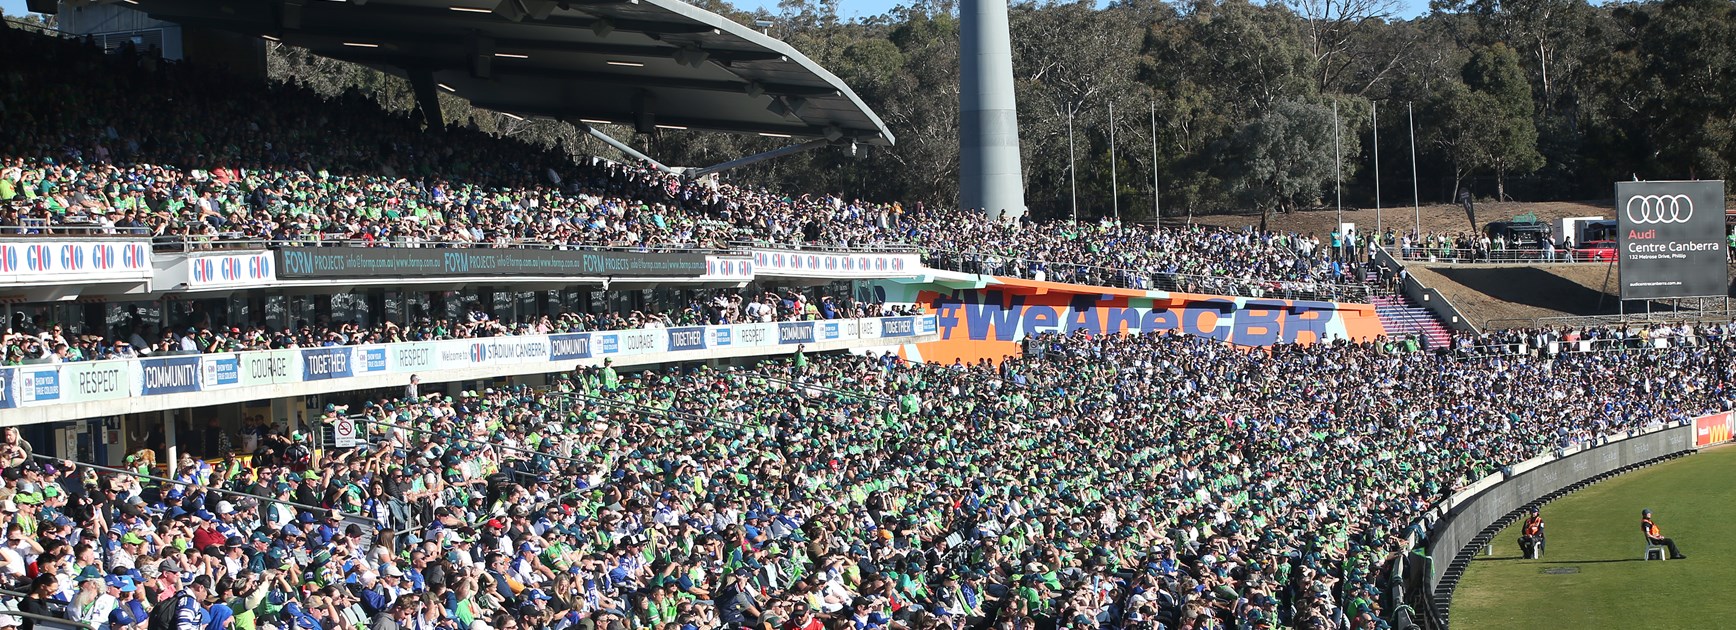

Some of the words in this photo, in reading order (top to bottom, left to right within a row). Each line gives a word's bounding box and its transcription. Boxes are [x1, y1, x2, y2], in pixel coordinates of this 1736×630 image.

[1628, 230, 1655, 239] Audi
[1628, 242, 1666, 253] Centre
[1668, 241, 1719, 252] Canberra
[26, 244, 51, 271] GIO
[60, 244, 84, 270] GIO
[92, 244, 115, 270] GIO
[122, 244, 144, 269] GIO
[284, 251, 314, 274] FORM
[314, 254, 344, 270] PROJECTS
[444, 252, 469, 272] FORM
[469, 255, 496, 269] PROJECTS
[583, 254, 605, 272] FORM
[605, 257, 630, 270] PROJECTS
[754, 252, 768, 267] GIO
[772, 253, 786, 268] GIO
[790, 254, 803, 269] GIO
[808, 255, 820, 270] GIO
[825, 256, 838, 270] GIO
[842, 256, 854, 270] GIO
[858, 257, 871, 271] GIO
[875, 257, 888, 271] GIO
[892, 257, 904, 271] GIO
[193, 258, 214, 282] GIO
[221, 256, 242, 281] GIO
[249, 255, 270, 279] GIO
[706, 260, 716, 276] IO
[720, 260, 734, 276] GIO
[738, 260, 752, 276] GIO
[742, 328, 766, 342] RESPECT
[781, 326, 814, 342] COMMUNITY
[848, 320, 874, 336] COUAGE
[885, 320, 910, 334] TOGETHER
[552, 338, 589, 356] COMMUNITY
[628, 334, 654, 350] COURAGE
[672, 332, 701, 347] TOGETHER
[400, 348, 429, 366] RESPECT
[442, 350, 460, 362] Welcome
[461, 350, 468, 361] to
[470, 344, 486, 362] GIO
[488, 344, 514, 360] STADIUM
[515, 342, 547, 358] CANBERRA
[252, 357, 286, 379] COURAGE
[308, 350, 346, 374] TOGETHER
[80, 369, 119, 394] RESPECT
[146, 364, 196, 388] COMMUNITY
